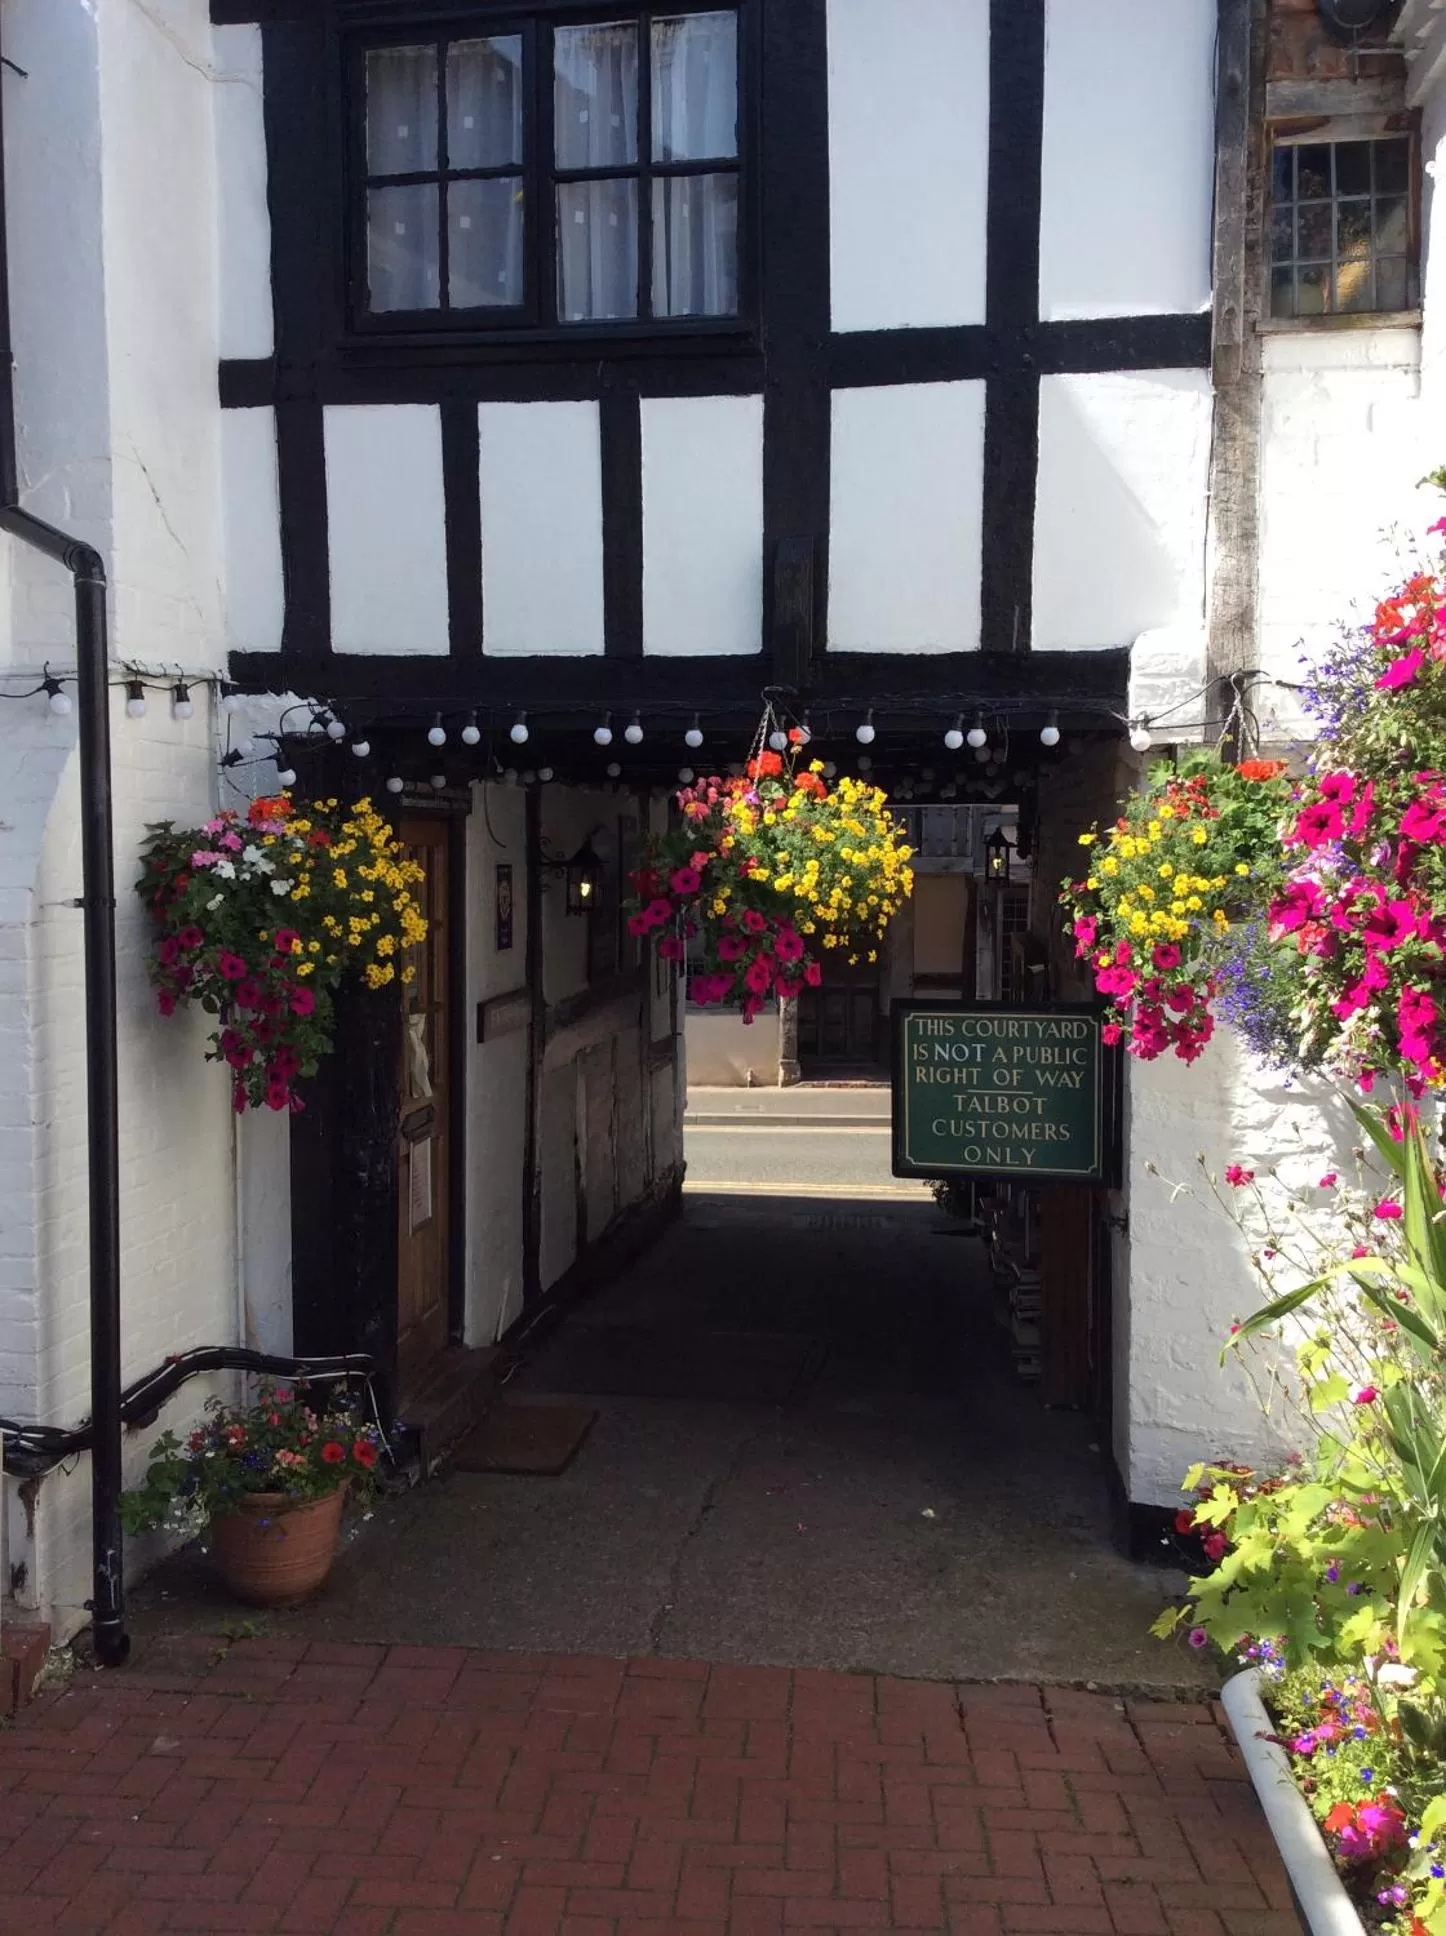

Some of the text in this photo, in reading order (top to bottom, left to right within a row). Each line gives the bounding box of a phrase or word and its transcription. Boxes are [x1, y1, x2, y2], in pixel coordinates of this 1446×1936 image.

[915, 1019, 1088, 1039] THIS COURTYARD
[913, 1043, 1088, 1065] IS NOT A PUBLIC
[915, 1066, 1084, 1088] RIGHT OF WAY
[953, 1095, 1048, 1115] TALBOT
[932, 1119, 1070, 1140] CUSTOMERS
[964, 1145, 1036, 1165] ONLY
